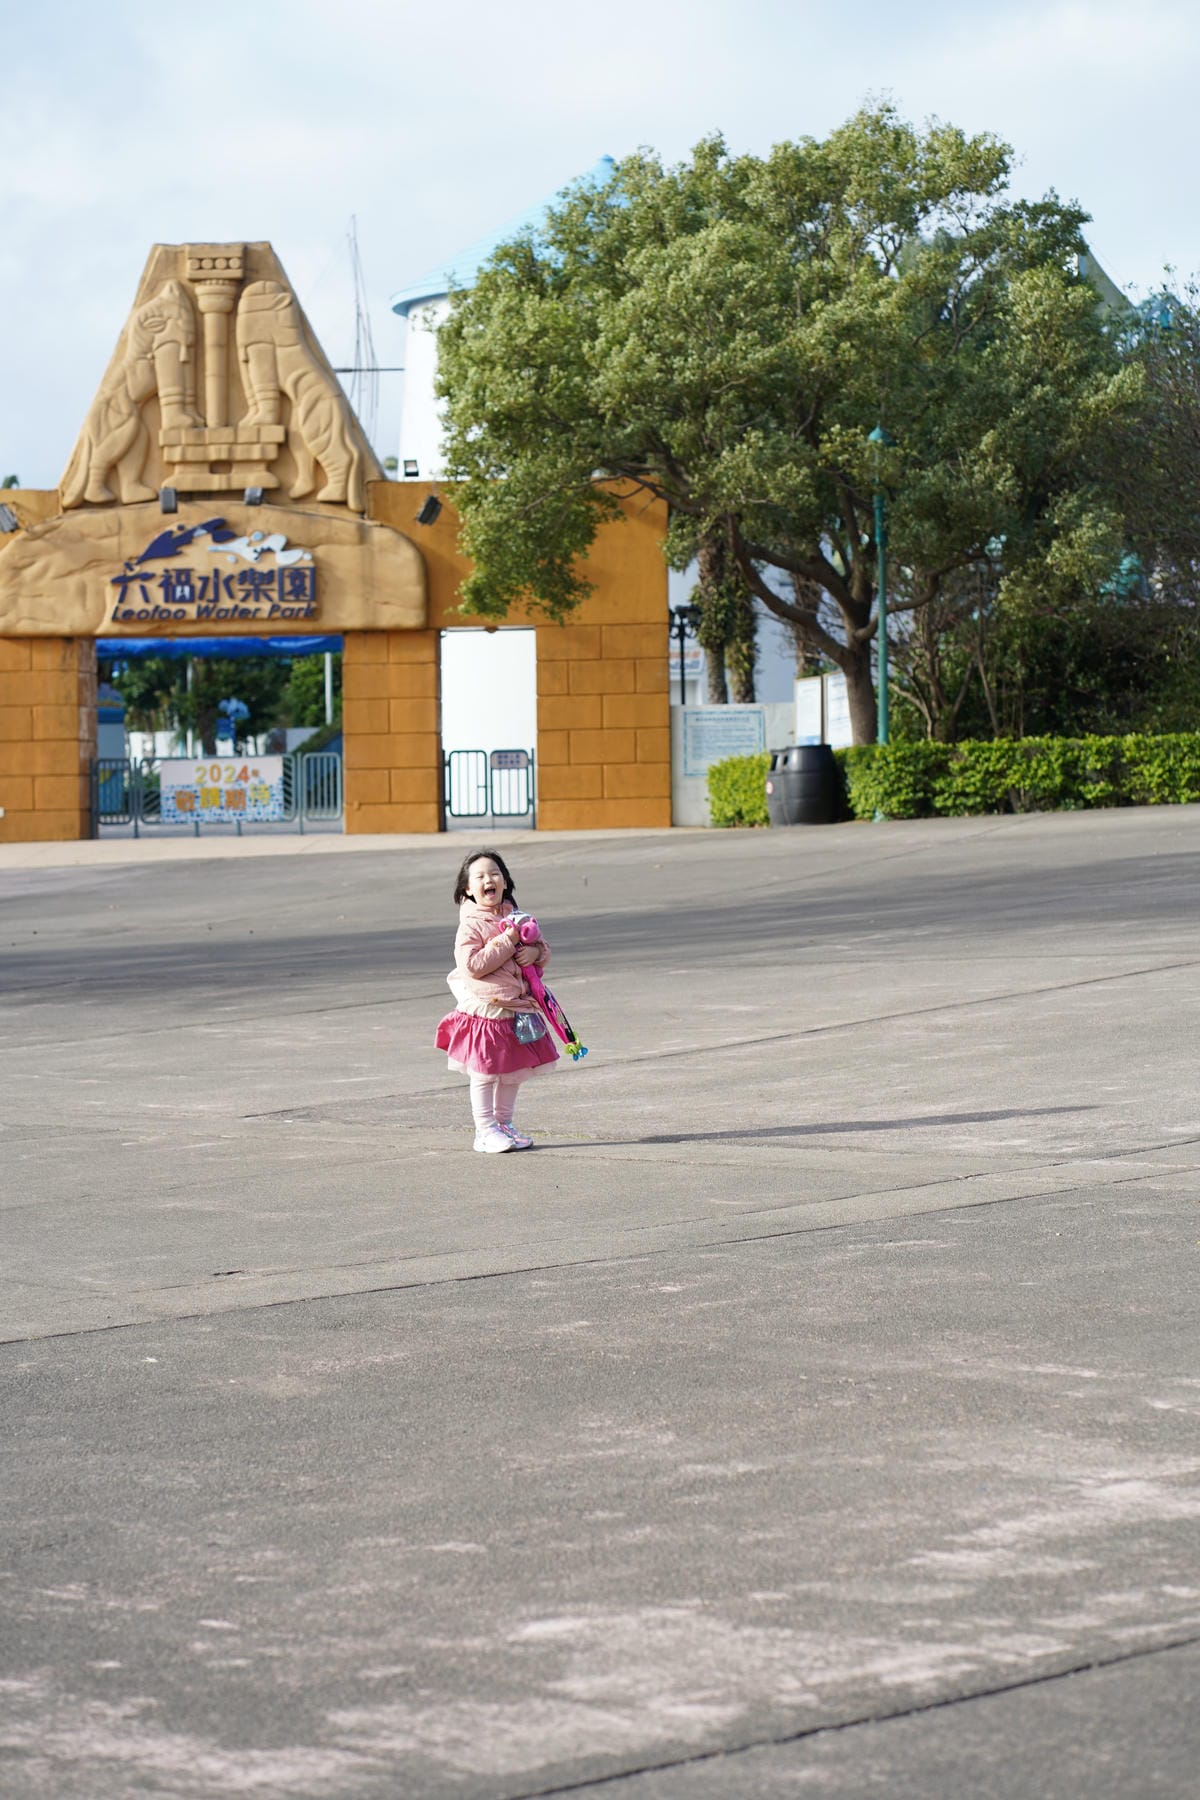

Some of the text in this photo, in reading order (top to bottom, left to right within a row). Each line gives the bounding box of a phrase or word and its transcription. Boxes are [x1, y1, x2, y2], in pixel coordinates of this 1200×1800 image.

[111, 562, 317, 604] 六福水樂園
[111, 604, 316, 621] Leofoo Water Park
